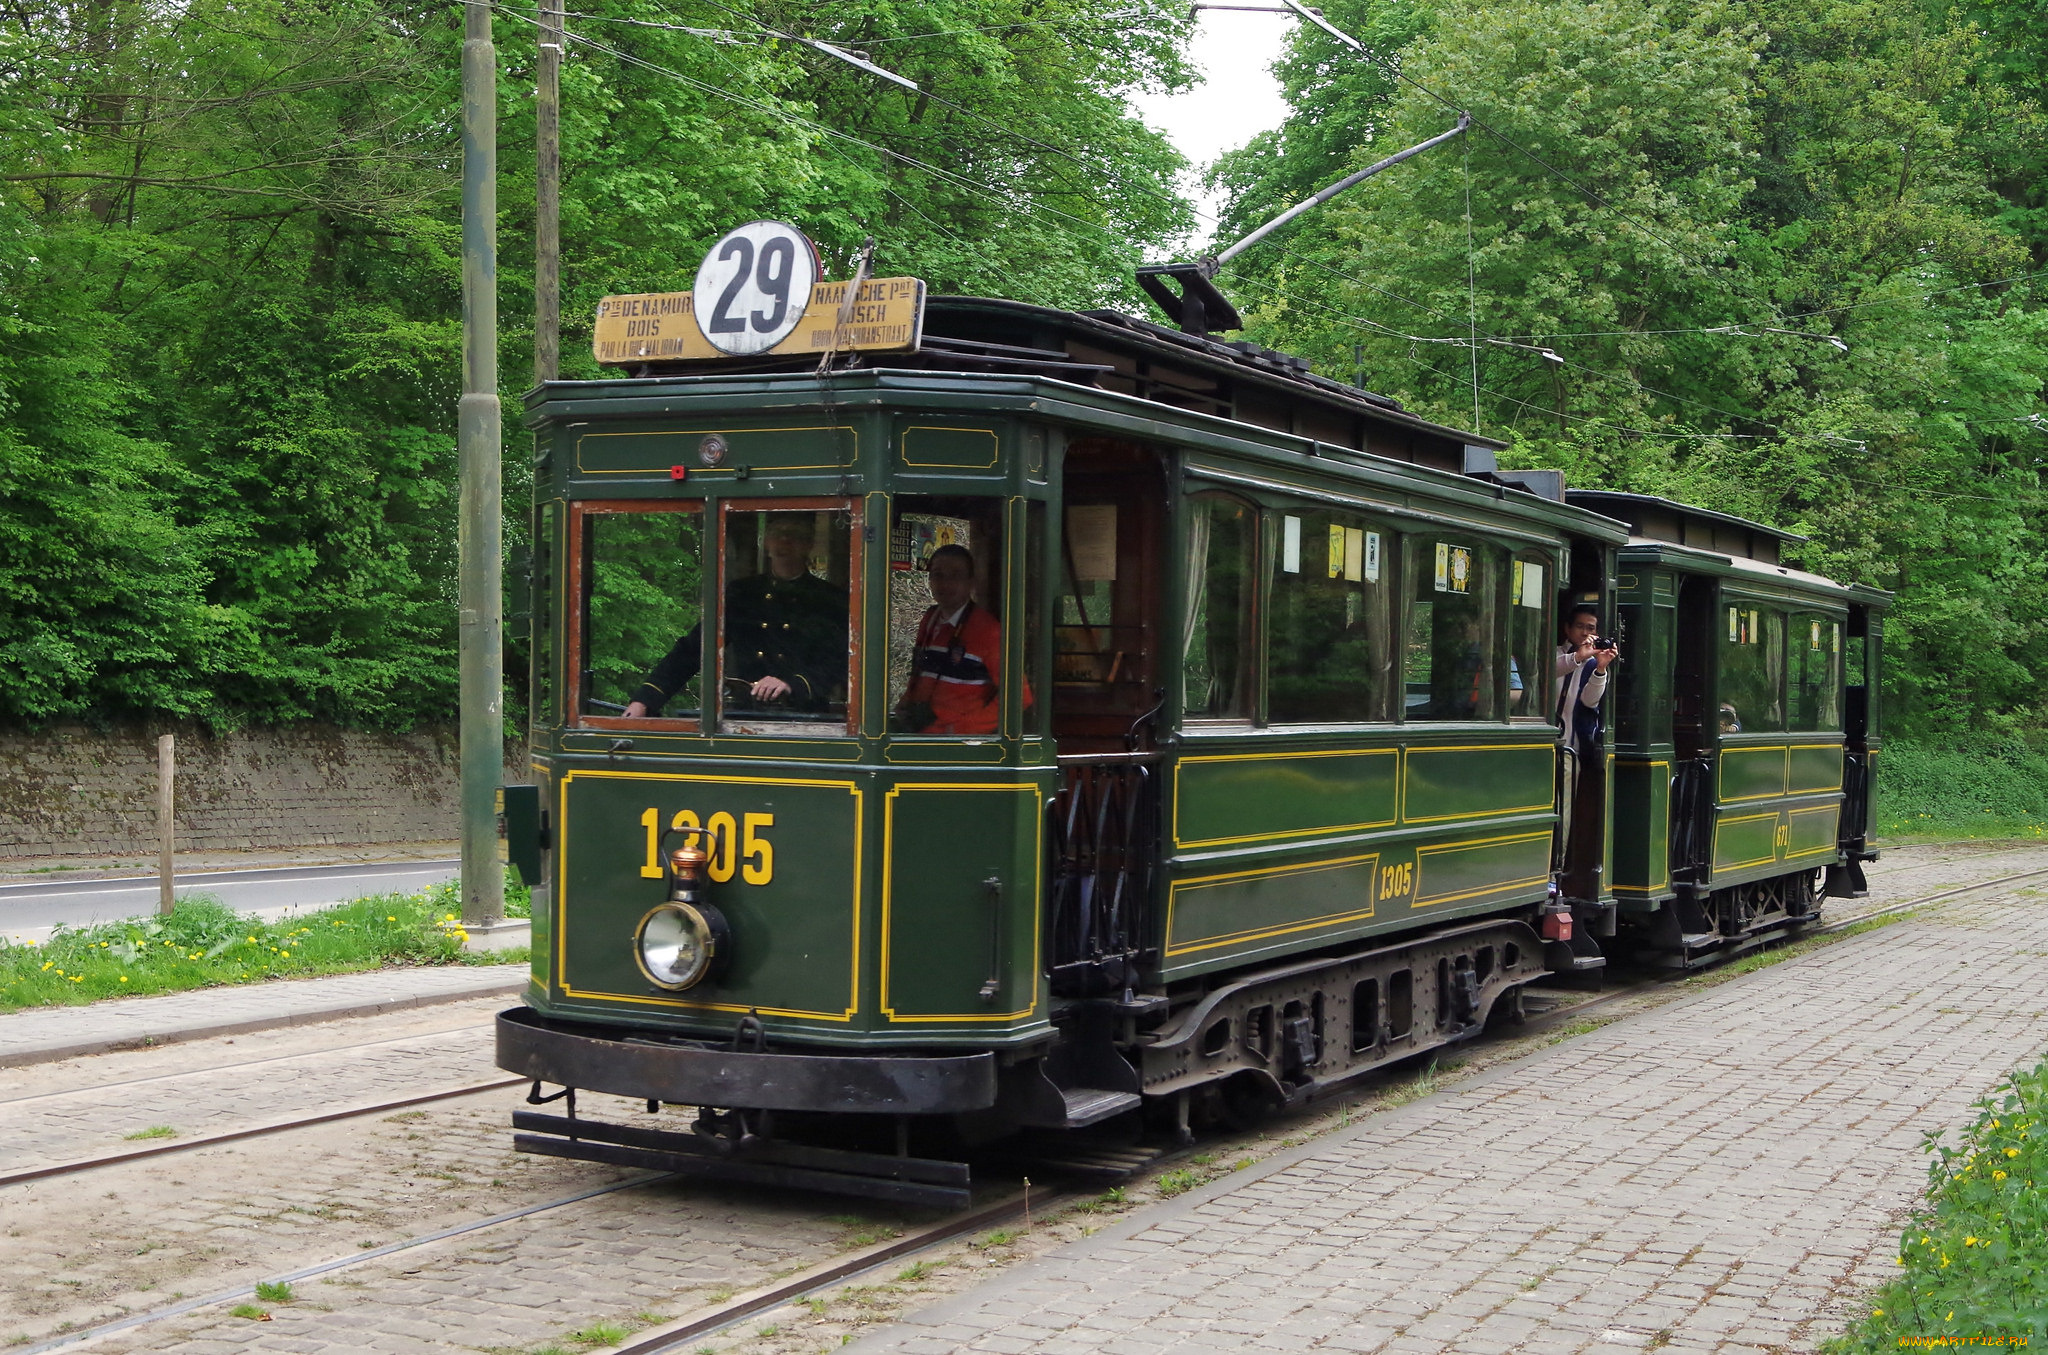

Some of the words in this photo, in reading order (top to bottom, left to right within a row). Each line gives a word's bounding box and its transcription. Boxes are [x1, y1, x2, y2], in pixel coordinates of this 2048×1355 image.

[709, 236, 795, 334] 29
[815, 283, 886, 305] NAACHE
[642, 297, 691, 316] NAMUR
[627, 319, 660, 337] BOIS
[601, 341, 615, 358] PAR
[617, 340, 627, 357] LA
[640, 807, 774, 886] 1305
[1777, 825, 1788, 847] 671
[1380, 862, 1413, 900] 1305
